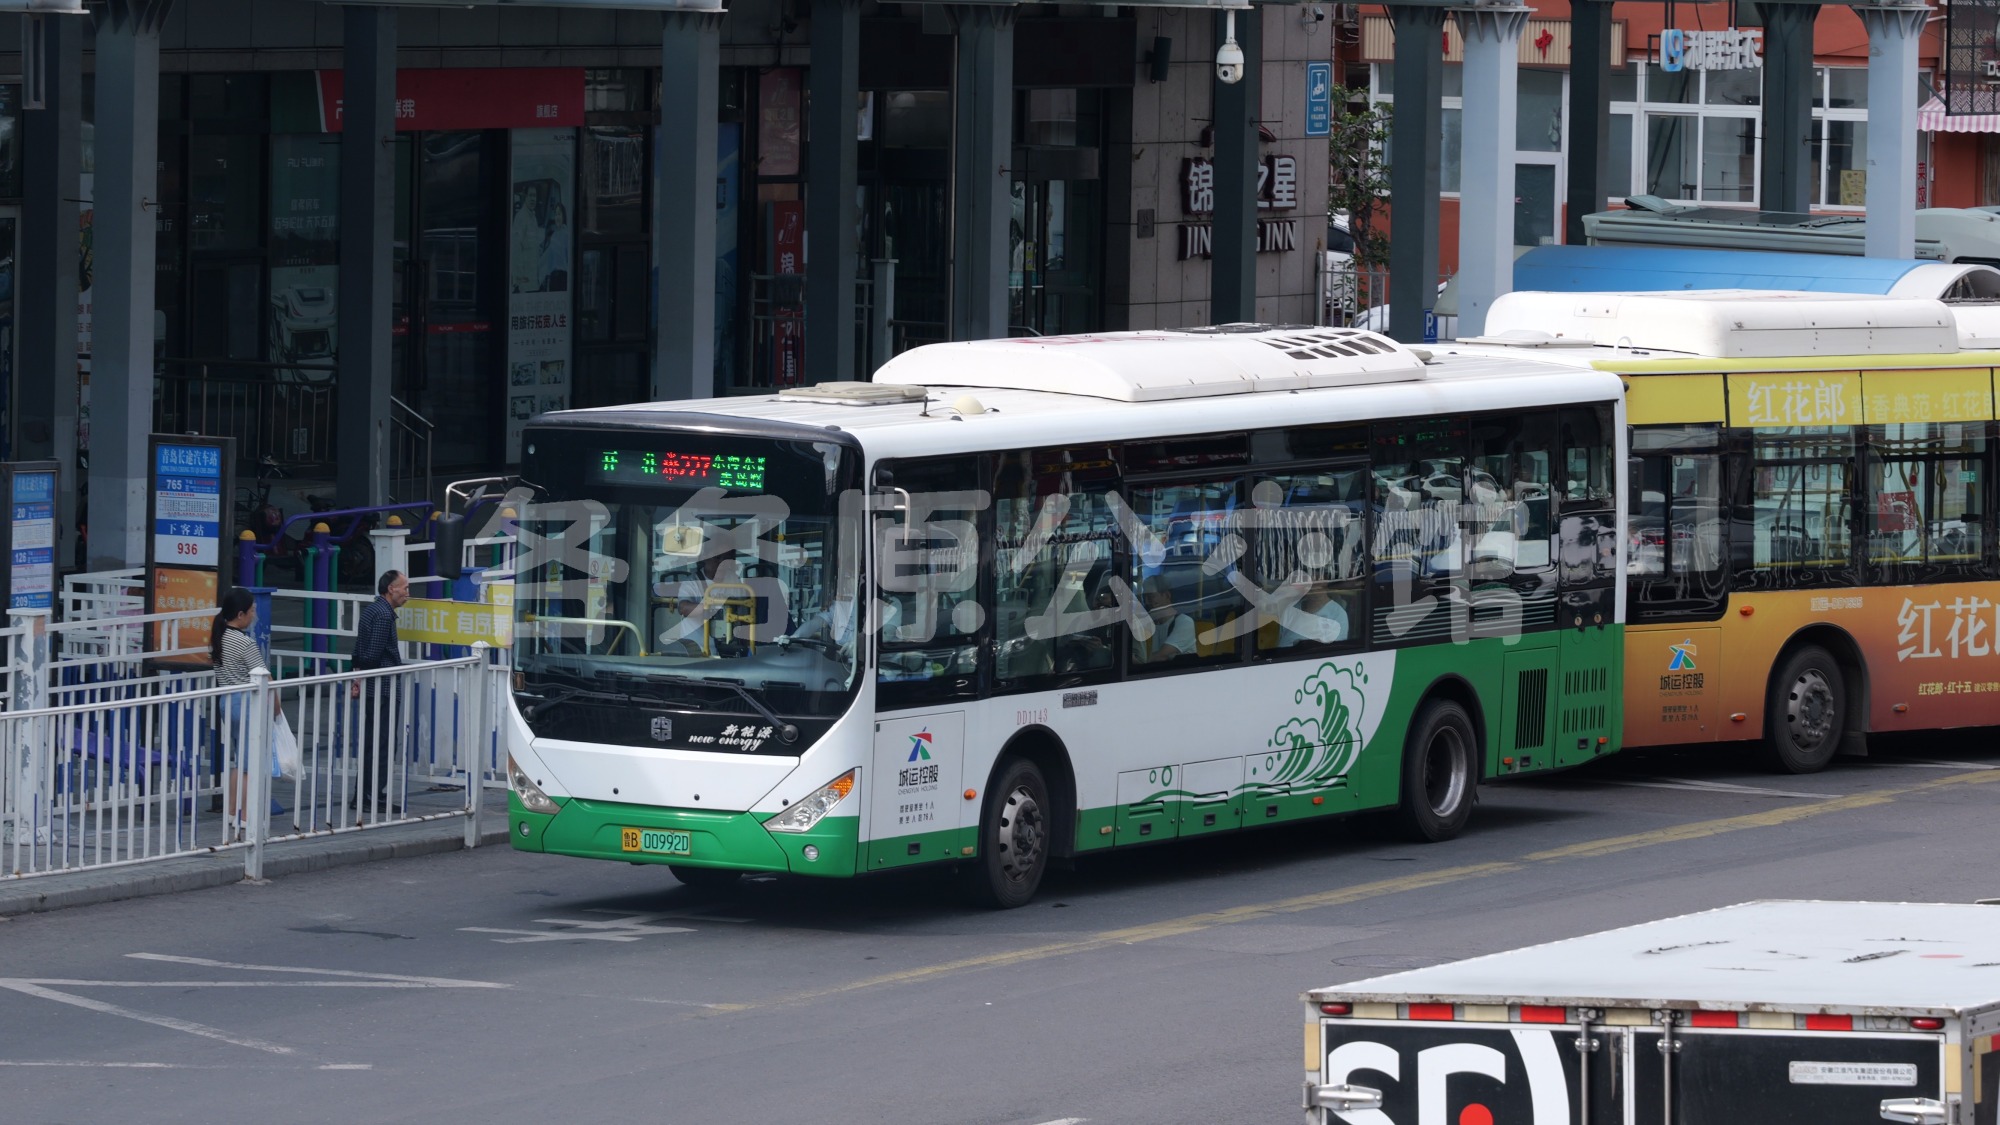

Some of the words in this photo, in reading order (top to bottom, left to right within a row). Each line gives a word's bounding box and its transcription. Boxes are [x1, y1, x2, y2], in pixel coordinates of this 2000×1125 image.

[1684, 27, 1763, 70] 利群洗衣
[1266, 221, 1296, 251] INN
[511, 314, 567, 331] 用旅行拓宽人生
[1426, 313, 1434, 336] P
[1748, 379, 1845, 424] 红花郎
[162, 448, 218, 467] 青岛长途汽车站
[166, 479, 182, 490] 765
[17, 508, 25, 519] 20
[169, 523, 205, 537] 下客站
[177, 542, 198, 555] 936
[15, 552, 27, 563] 126
[15, 596, 28, 607] 209
[1897, 595, 2000, 663] 红花
[1660, 673, 1704, 690] 城运控股
[1017, 708, 1048, 725] DD1143
[721, 724, 773, 739] 新能源
[688, 735, 717, 743] new
[718, 736, 765, 752] energy
[898, 765, 939, 787] 城运控股
[898, 787, 920, 796] CHENGYUN
[920, 784, 938, 793] HOLDING
[624, 832, 639, 848] 鲁B
[644, 833, 689, 851] 00992D
[1820, 1066, 1913, 1076] 安徽江淮汽车集团股份有限公司
